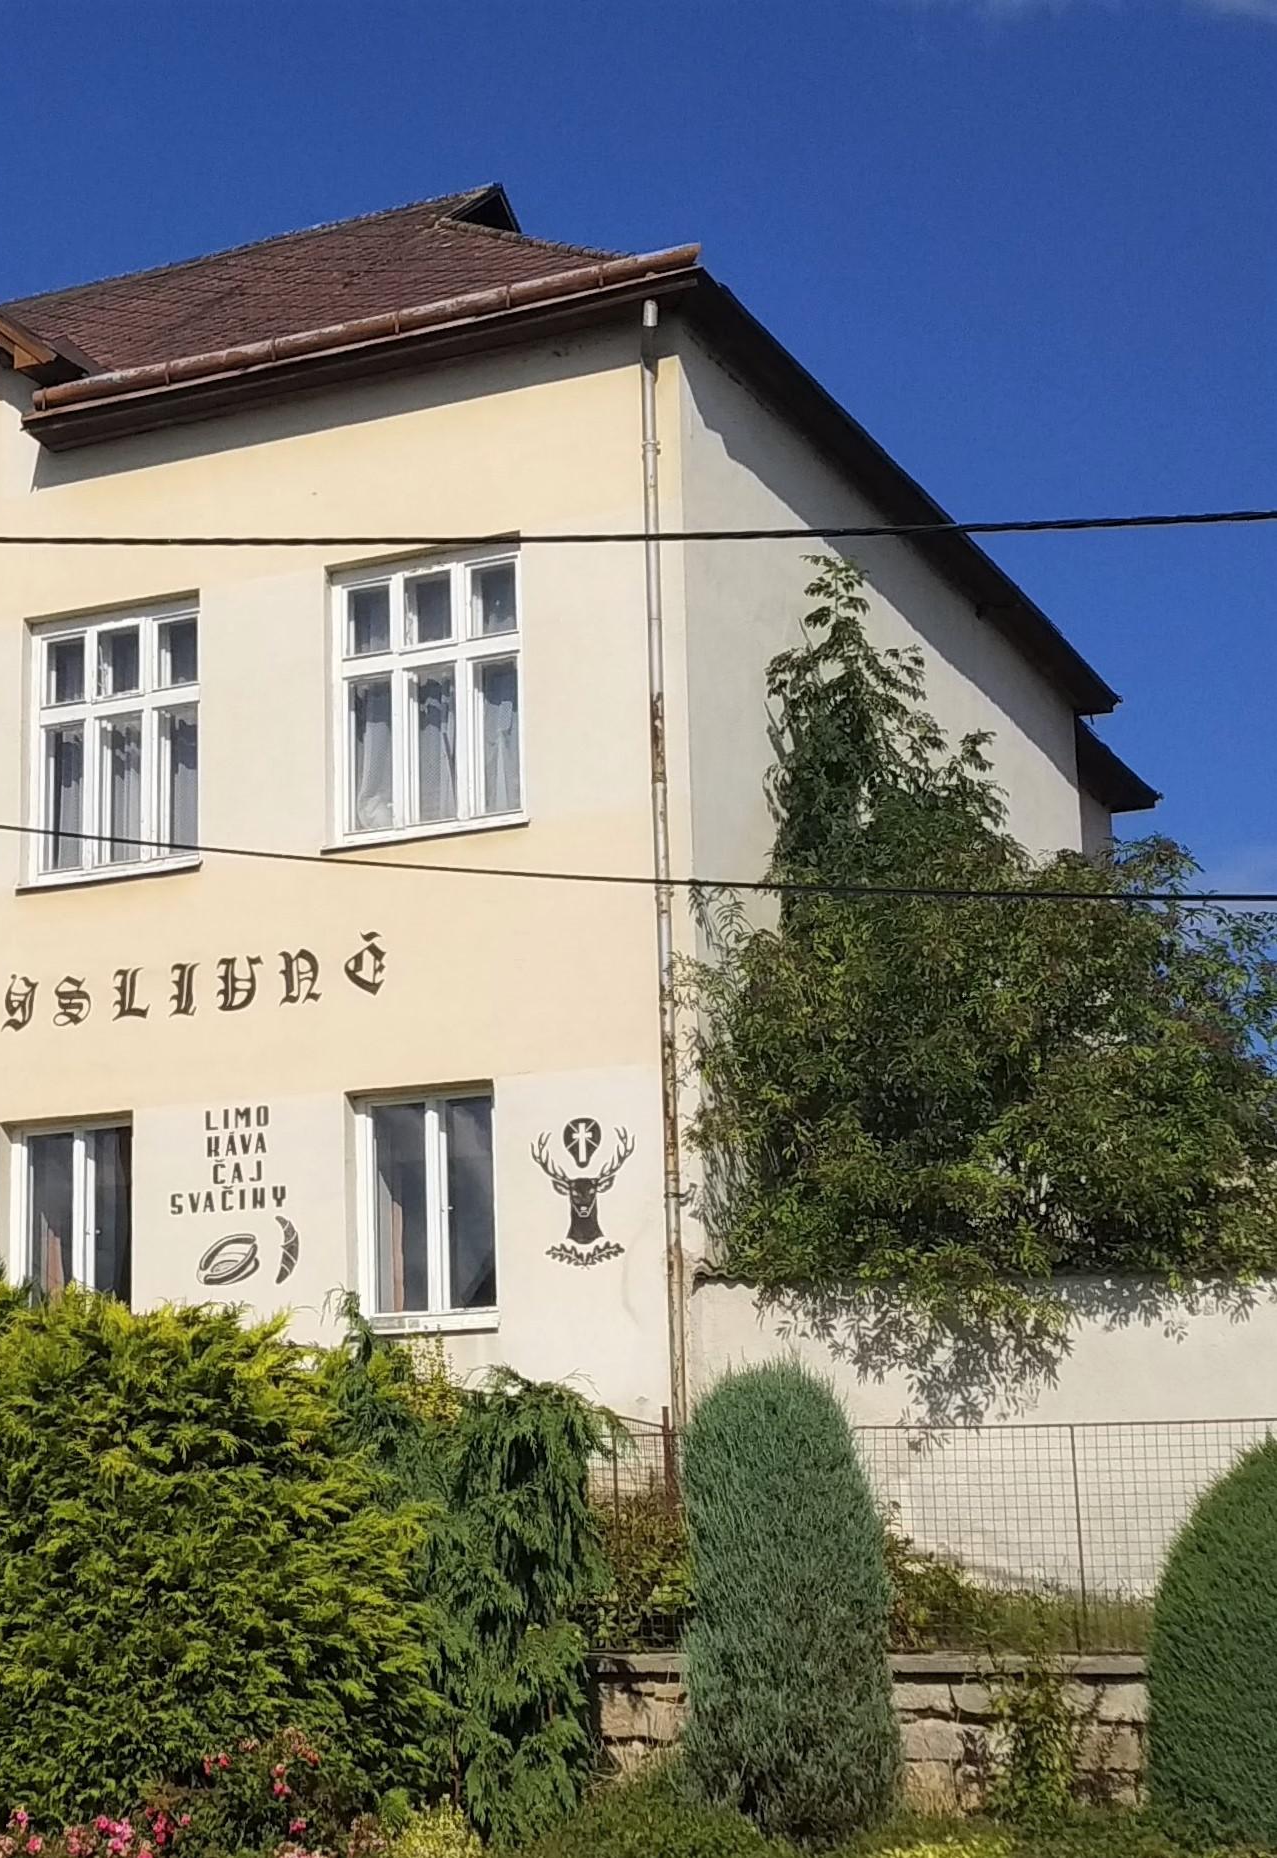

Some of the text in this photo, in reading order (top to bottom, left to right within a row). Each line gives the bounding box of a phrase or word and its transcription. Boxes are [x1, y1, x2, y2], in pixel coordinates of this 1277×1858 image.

[205, 1105, 269, 1131] LIMO
[206, 1131, 267, 1158] KÁVA
[212, 1158, 262, 1185] ČAJ
[170, 1185, 287, 1215] SVAČINY
